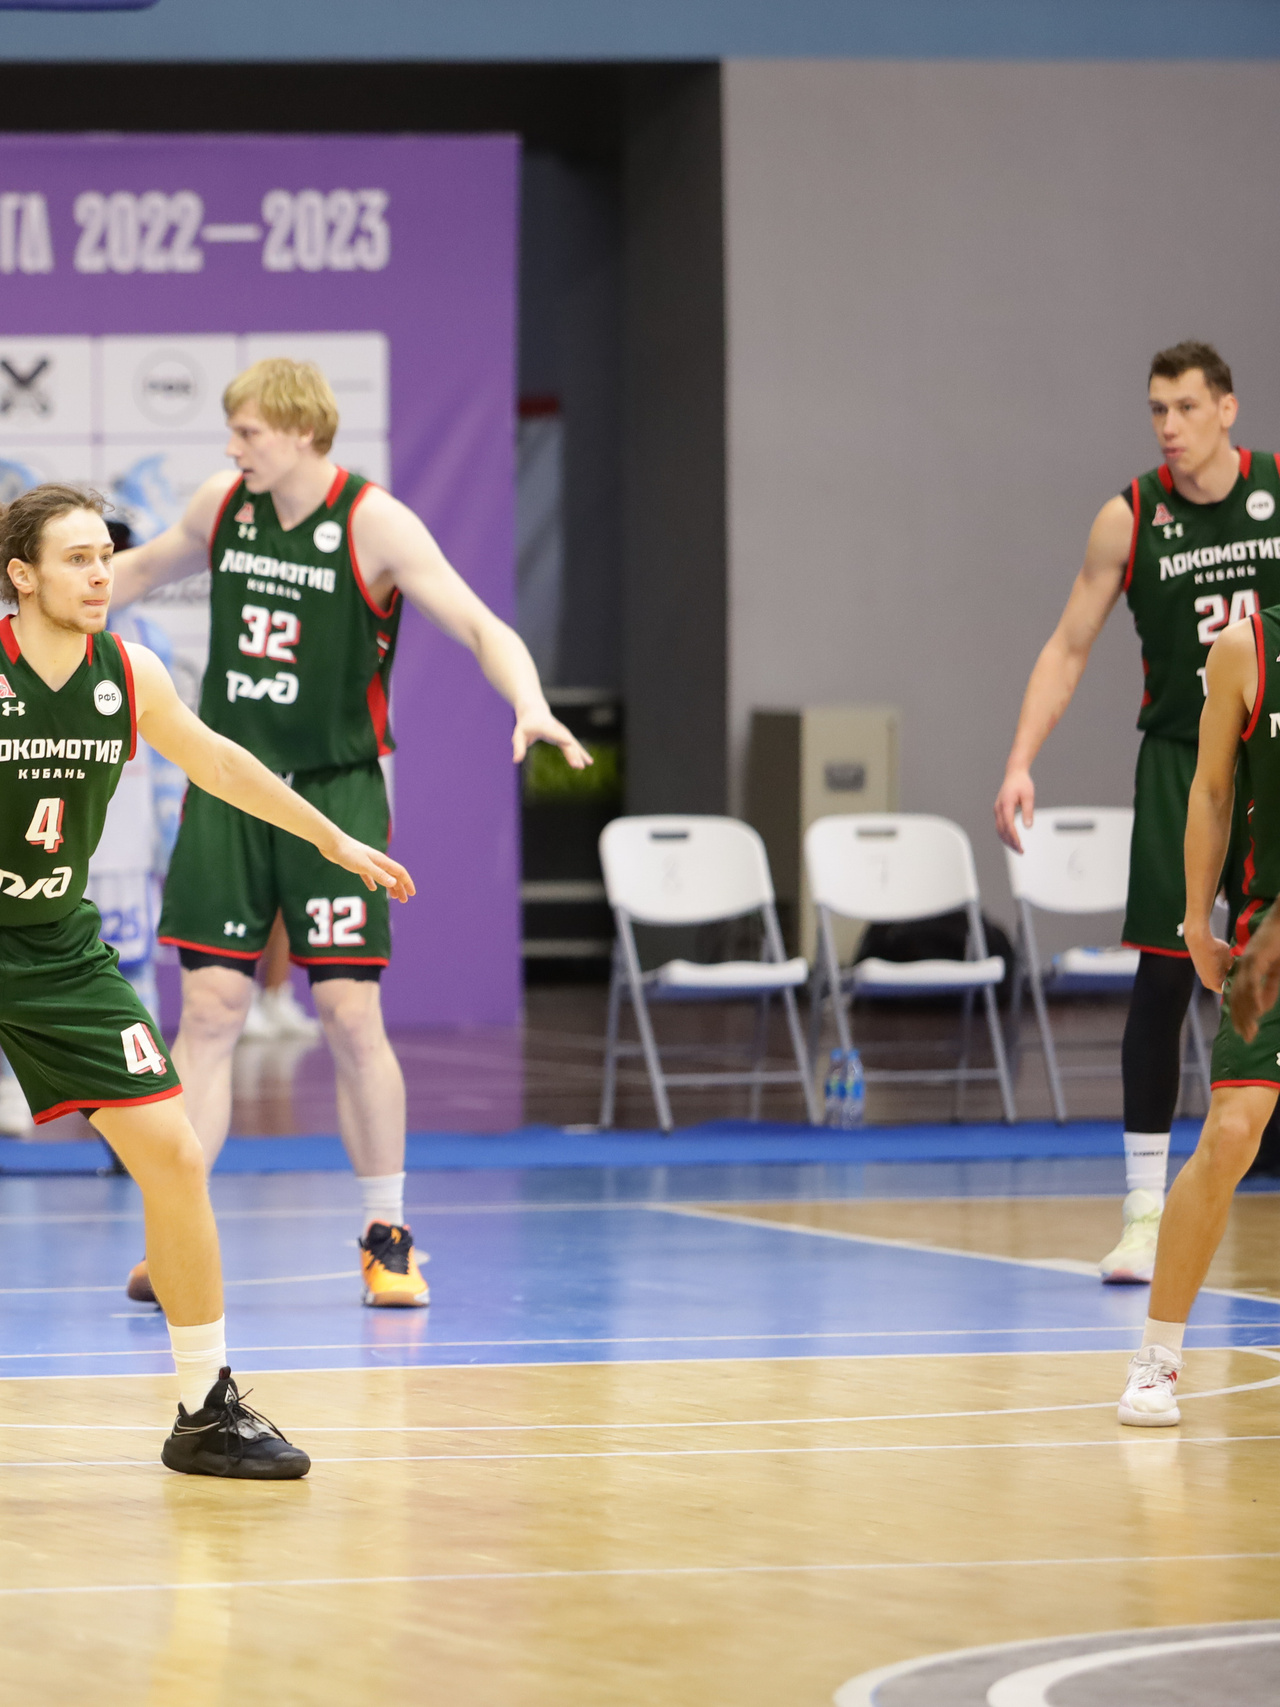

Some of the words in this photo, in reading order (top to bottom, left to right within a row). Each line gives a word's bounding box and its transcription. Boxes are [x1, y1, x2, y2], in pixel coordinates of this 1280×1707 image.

[219, 548, 336, 594] ЛОКОМОТИВ
[246, 578, 302, 601] КУБАНЬ
[1194, 564, 1257, 585] КУБАНЬ
[238, 603, 301, 664] 32
[97, 692, 118, 703] РФБ
[18, 768, 86, 780] КУБАНЬ
[25, 797, 65, 853] 4
[305, 896, 367, 948] 32
[120, 1022, 168, 1076] 4
